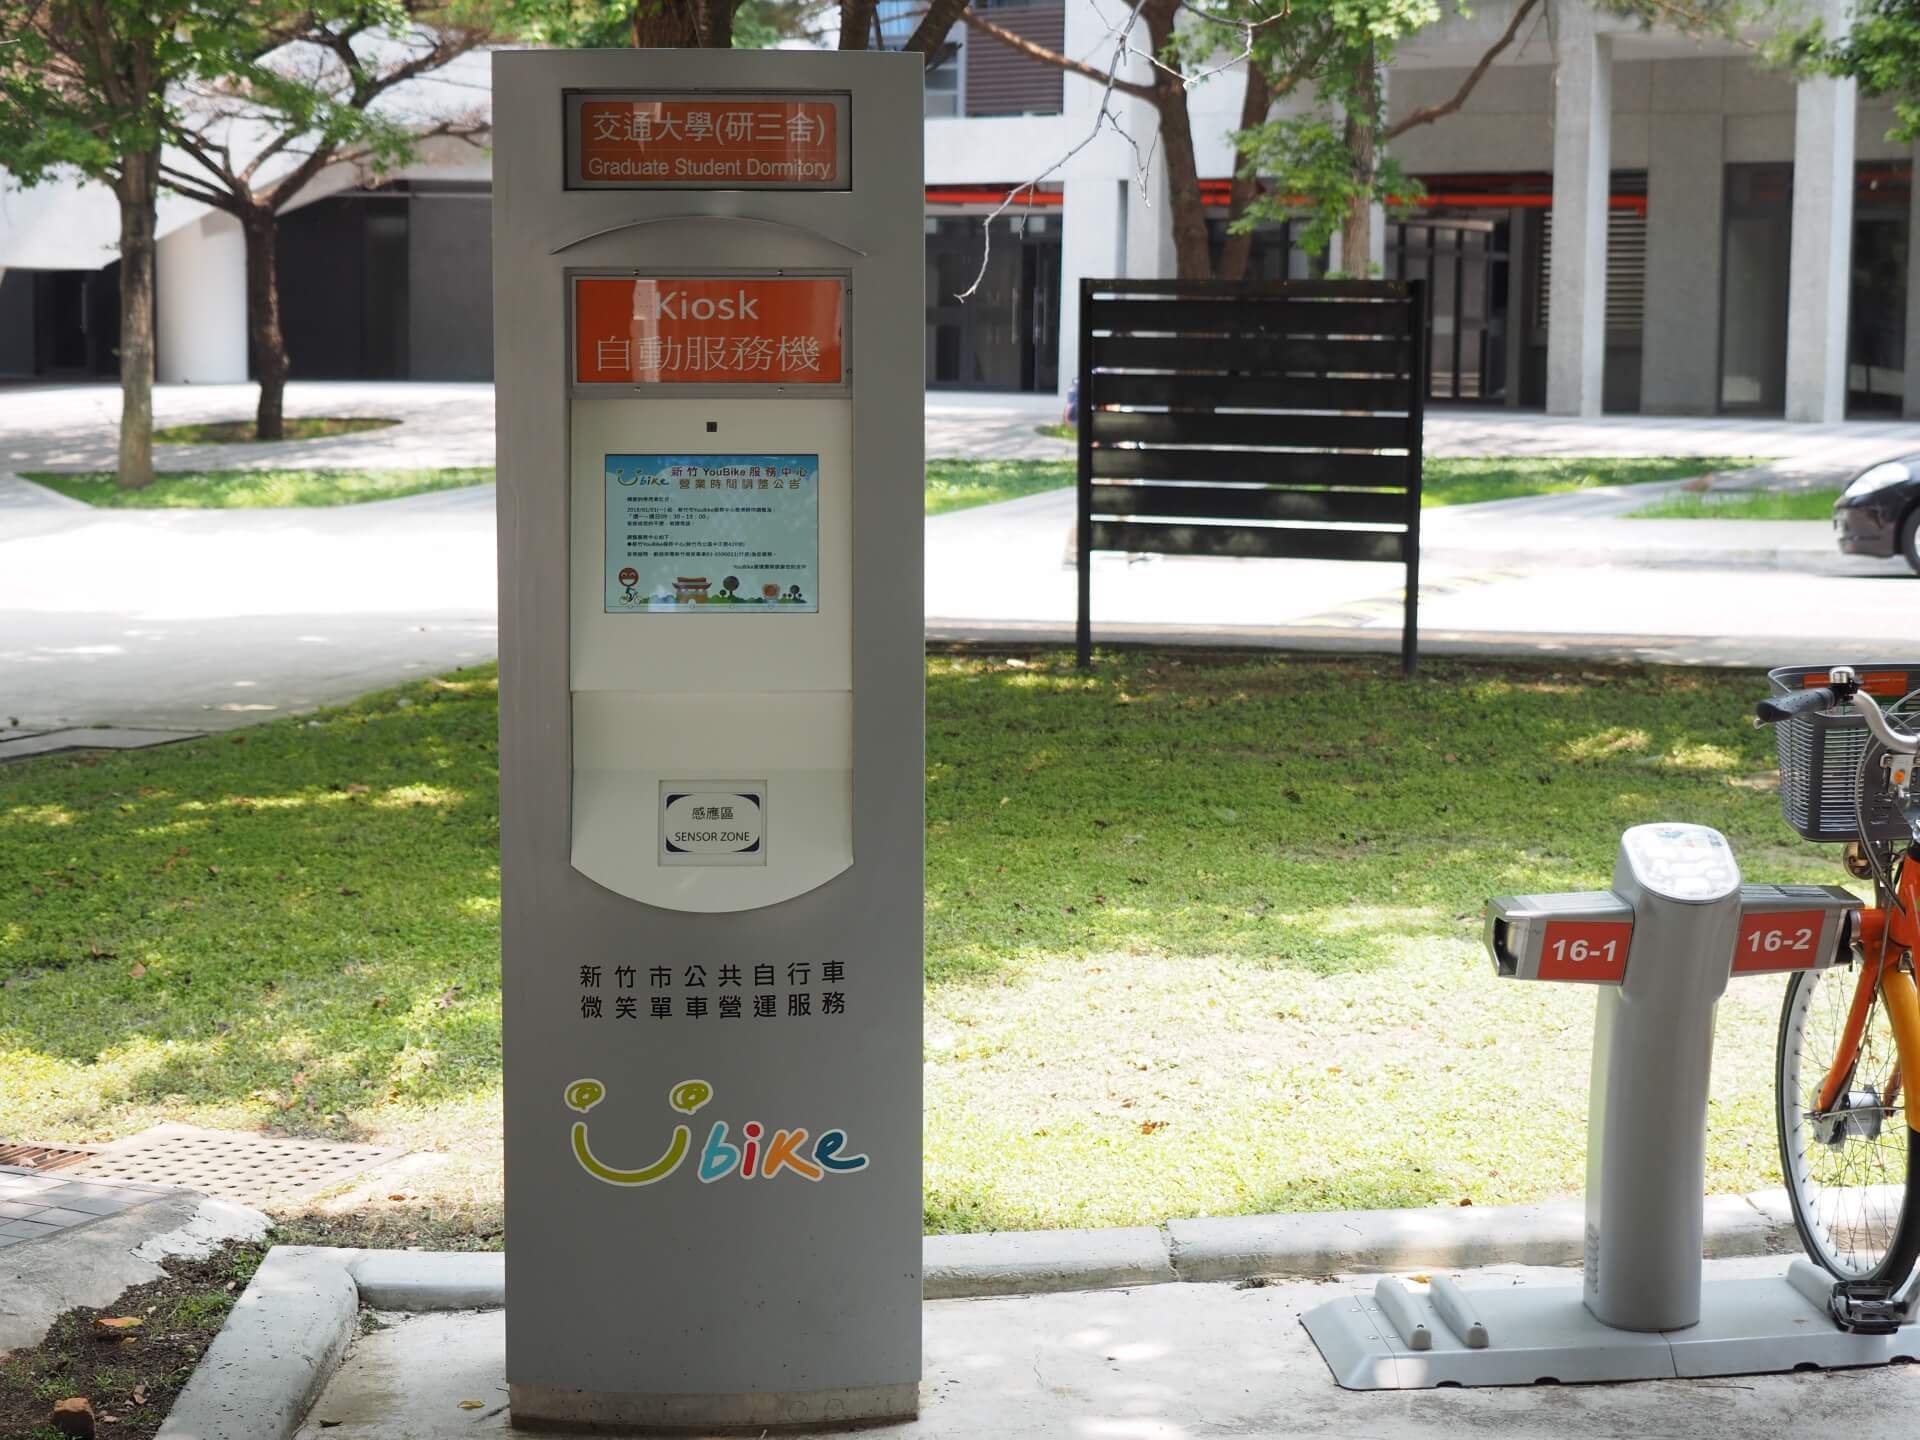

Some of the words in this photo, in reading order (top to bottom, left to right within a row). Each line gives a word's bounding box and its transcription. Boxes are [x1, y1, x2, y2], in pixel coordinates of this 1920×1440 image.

[592, 111, 826, 146] 交通大學(研三舍)
[588, 157, 669, 177] Graduate
[674, 158, 741, 177] Student
[747, 158, 831, 180] Dormitory
[655, 289, 760, 321] Kiosk
[596, 335, 820, 372] 自動服務機
[702, 467, 746, 477] YouBike
[691, 805, 734, 821] 感應區
[675, 831, 718, 842] SENSOR
[720, 831, 750, 842] ZONE
[1551, 938, 1618, 962] 16-1
[1747, 928, 1812, 953] 16-2
[579, 960, 846, 989] 新竹市公共自行車
[580, 991, 846, 1020] 微笑單車營運服務
